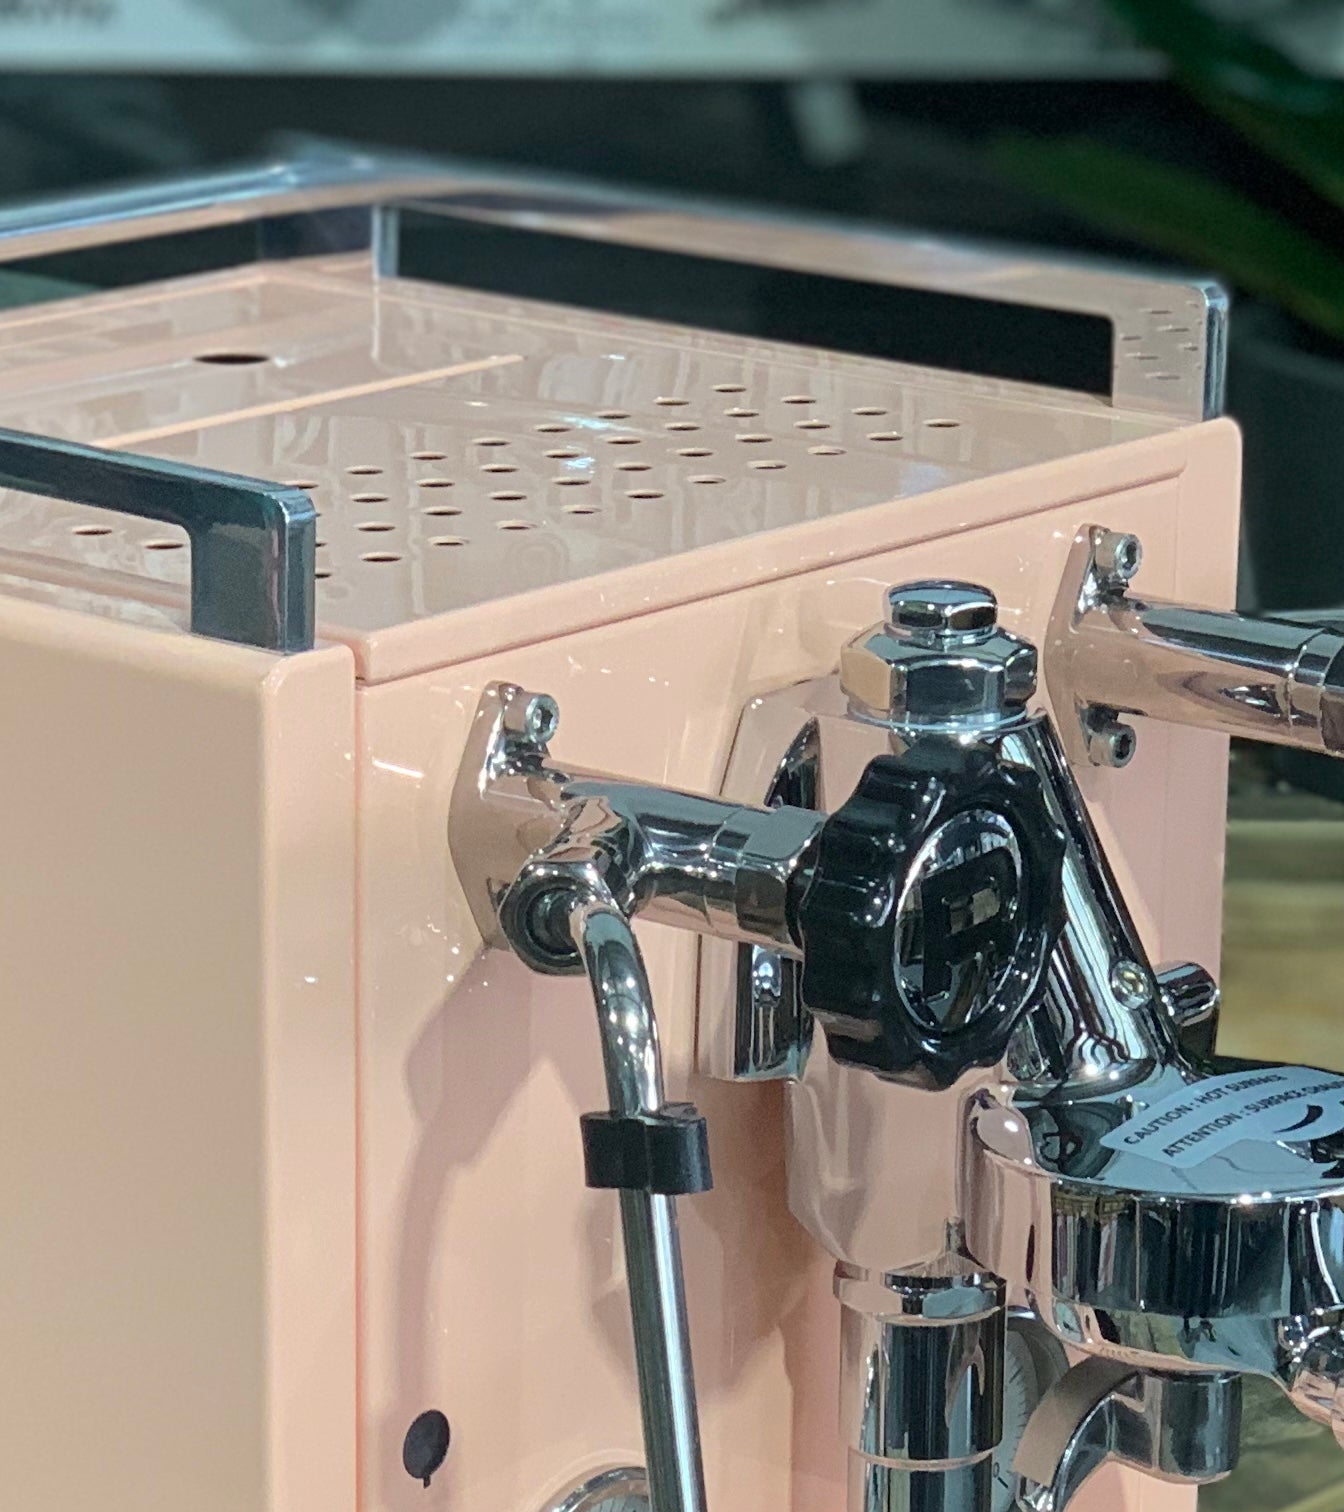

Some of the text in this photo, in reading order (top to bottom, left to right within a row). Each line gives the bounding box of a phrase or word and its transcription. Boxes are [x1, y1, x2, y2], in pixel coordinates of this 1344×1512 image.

[1123, 1103, 1193, 1146] CAUTION
[1194, 1087, 1229, 1105] HOT
[1162, 1112, 1243, 1158] ATTENTION
